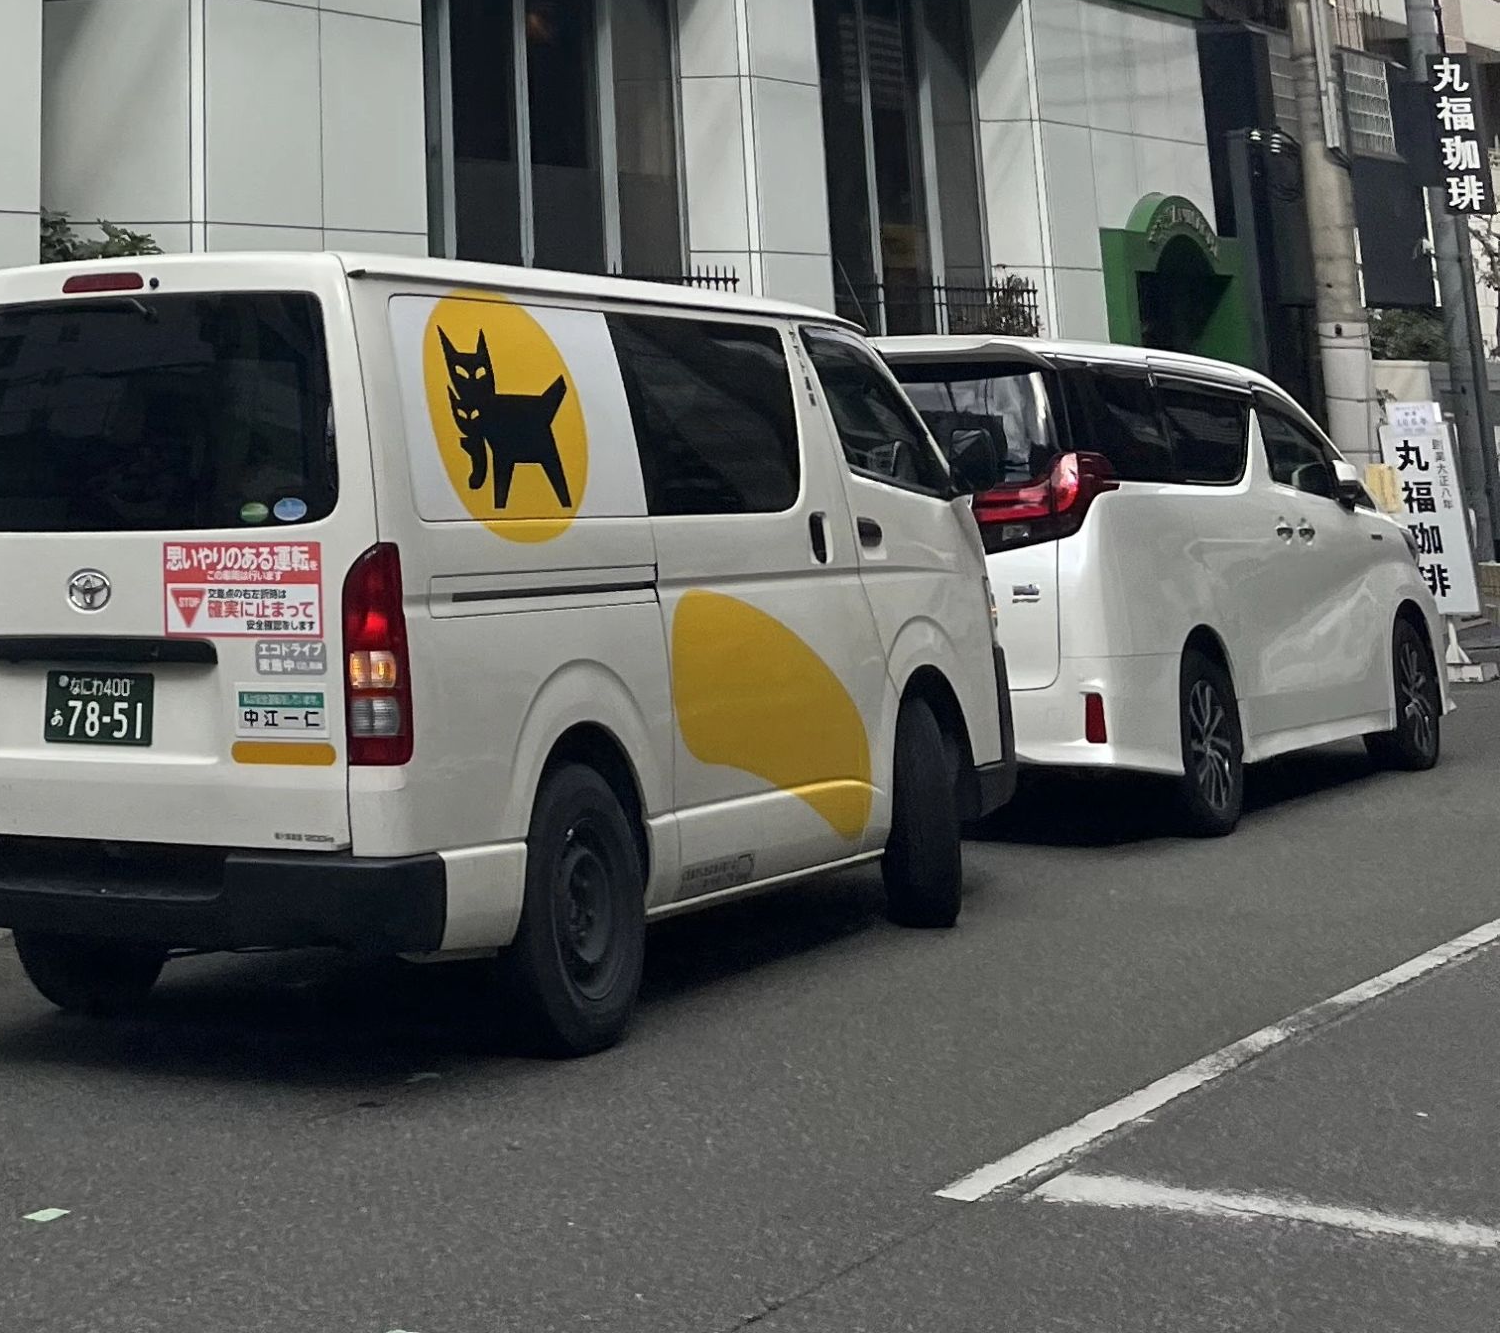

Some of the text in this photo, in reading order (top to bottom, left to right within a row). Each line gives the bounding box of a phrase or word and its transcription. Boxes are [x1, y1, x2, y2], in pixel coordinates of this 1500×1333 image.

[1433, 57, 1485, 211] 丸福珈琲
[1395, 439, 1451, 598] 丸福珈琲
[166, 545, 318, 572] 思いやりのある運転を
[178, 597, 201, 608] STOP
[208, 600, 315, 619] 確実に止まって
[258, 642, 323, 657] エコドライブ
[50, 699, 143, 740] あ 78-51
